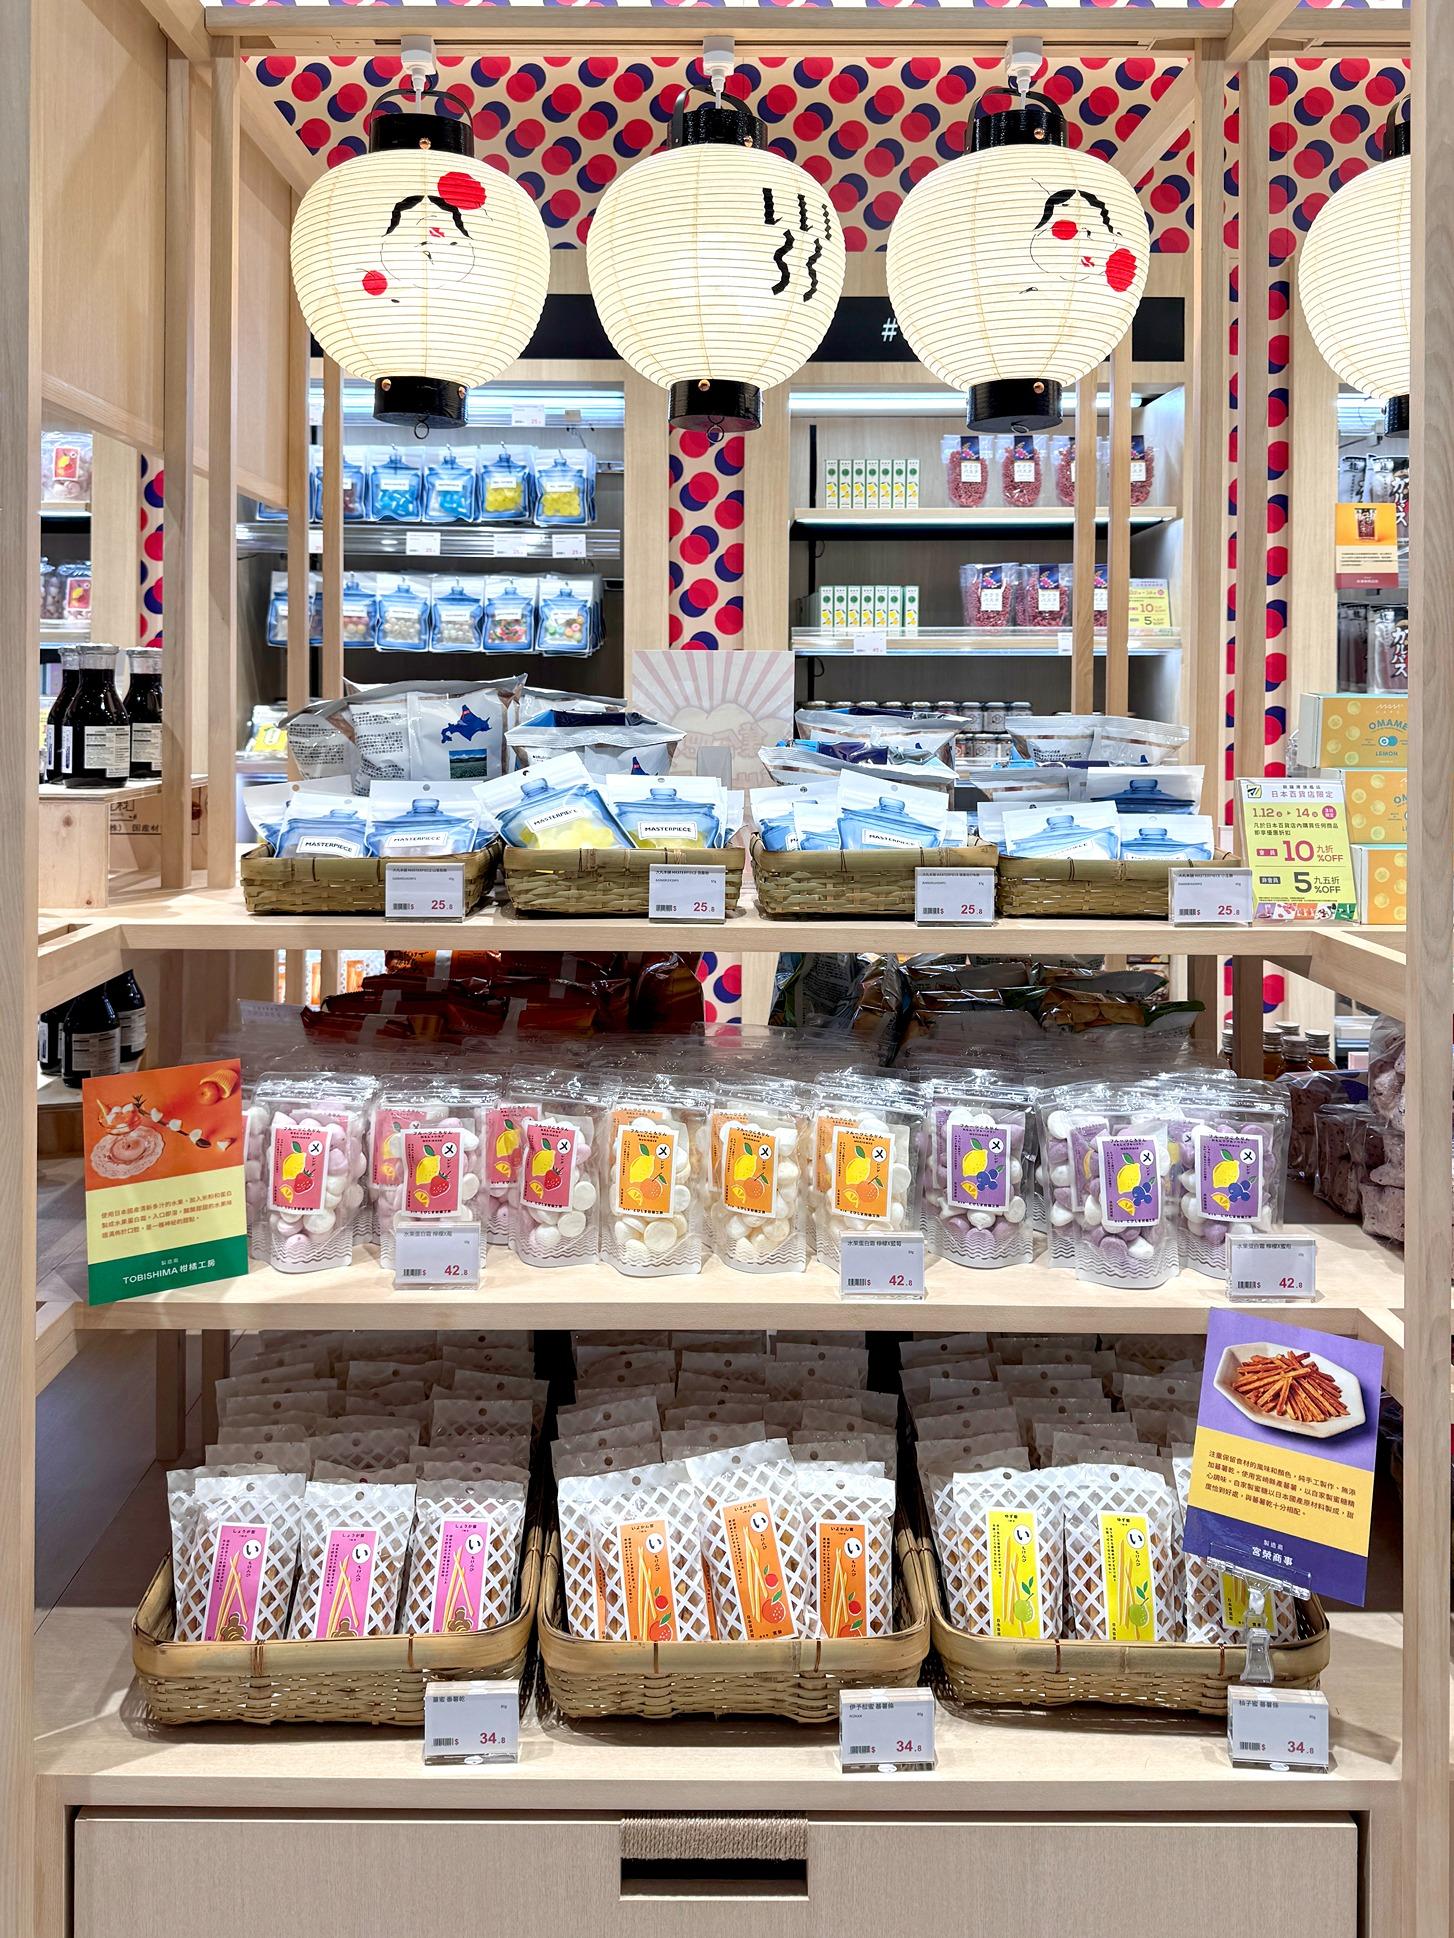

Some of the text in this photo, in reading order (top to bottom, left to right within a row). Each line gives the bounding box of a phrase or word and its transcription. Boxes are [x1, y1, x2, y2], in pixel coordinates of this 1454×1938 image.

[533, 808, 578, 825] MASTERPIECE
[1295, 807, 1310, 818] 14
[305, 841, 353, 852] MASTERPIECE
[1282, 839, 1315, 862] 10
[1316, 844, 1334, 854] 九折
[1317, 854, 1344, 862] %OFF
[1293, 871, 1313, 894] 5
[1313, 876, 1340, 885] 九五折
[1314, 885, 1341, 894] %OFF
[431, 899, 453, 910] 25.8
[693, 901, 715, 912] 25.8
[960, 904, 983, 915] 25.8
[1217, 905, 1240, 916] 25.8
[122, 1259, 216, 1285] TOBISHIMA 柑橘工房
[444, 1264, 469, 1276] 42.8
[888, 1274, 913, 1286] 42.8
[1279, 1277, 1303, 1289] 42.8
[1251, 1545, 1294, 1567] 宮榮商事
[454, 1732, 506, 1746] $ 34.8
[871, 1740, 922, 1754] $ 34.8
[1261, 1740, 1314, 1755] $ 34.8
